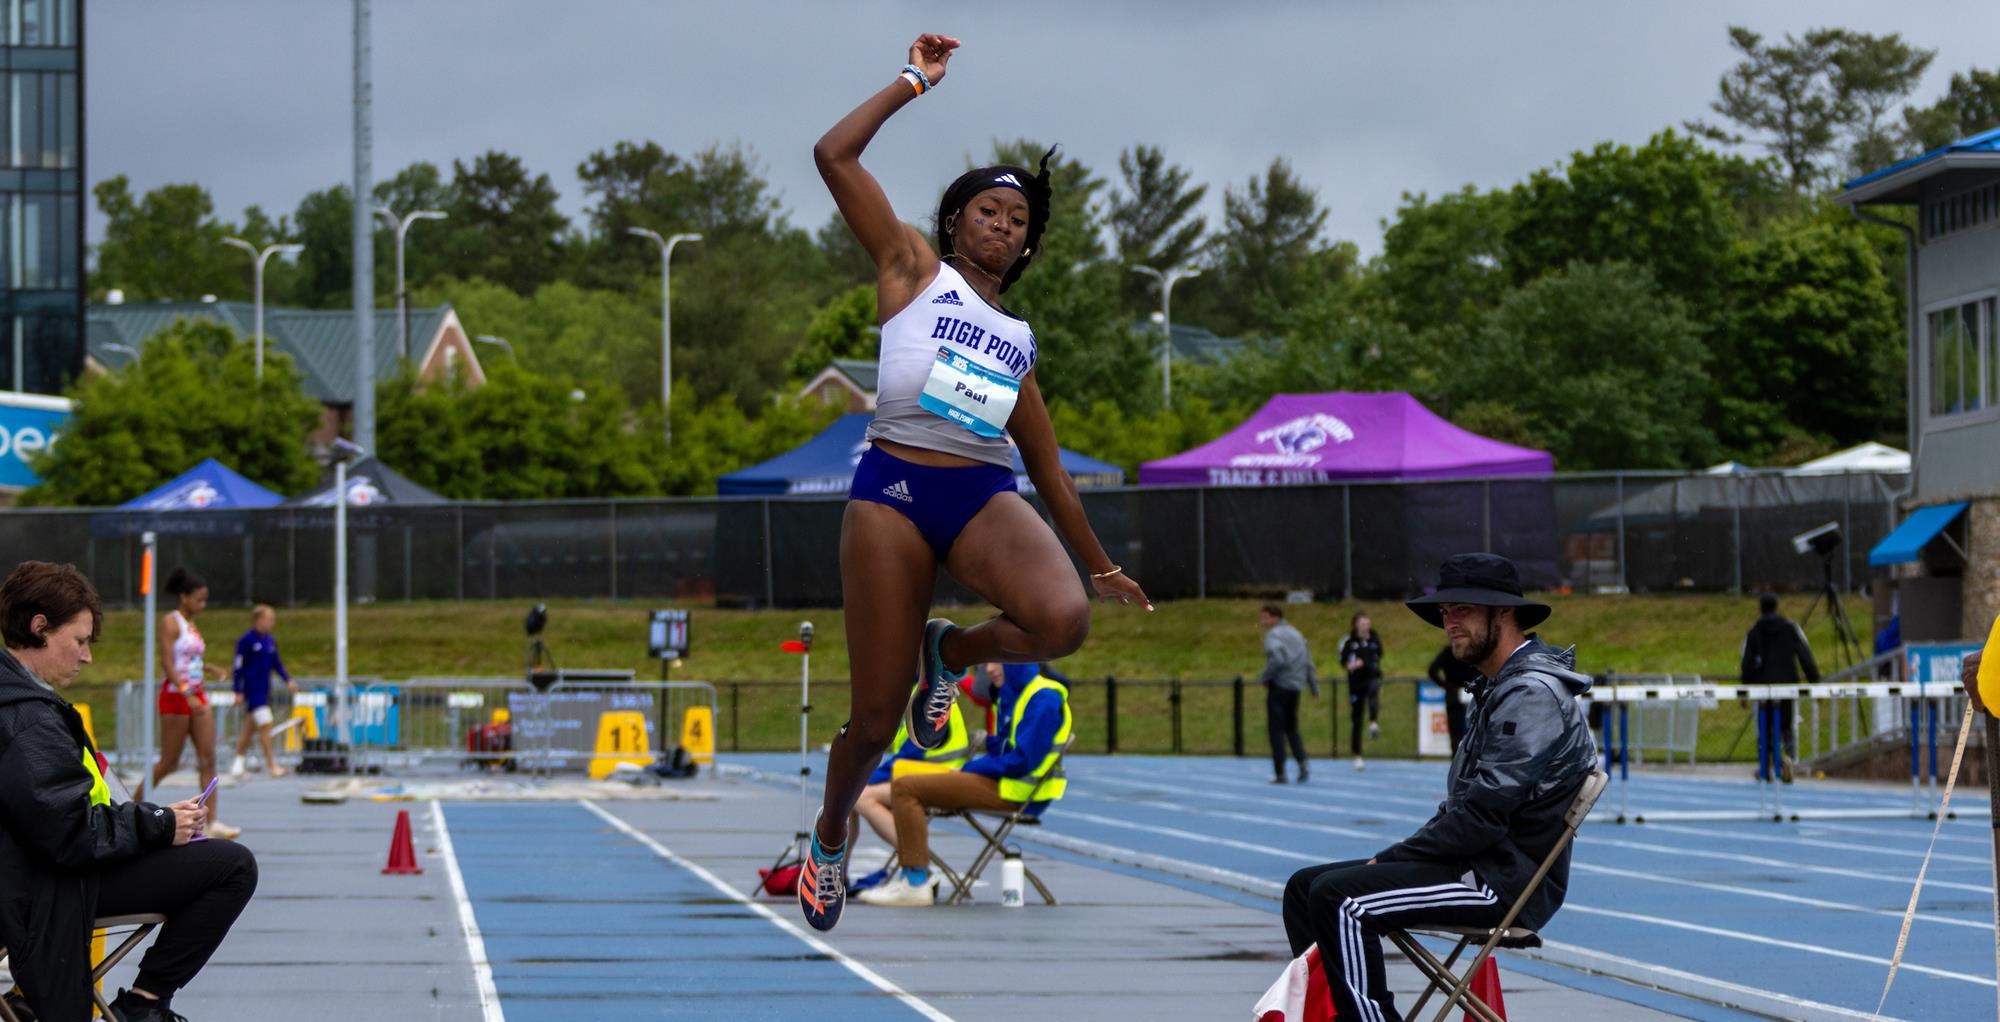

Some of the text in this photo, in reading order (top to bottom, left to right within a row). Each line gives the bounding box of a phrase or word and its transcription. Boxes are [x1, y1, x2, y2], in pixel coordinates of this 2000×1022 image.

[931, 298, 964, 306] adidas
[931, 317, 985, 350] HIGH
[984, 334, 1028, 378] POINT
[954, 381, 988, 405] Paul
[882, 488, 913, 502] adidas
